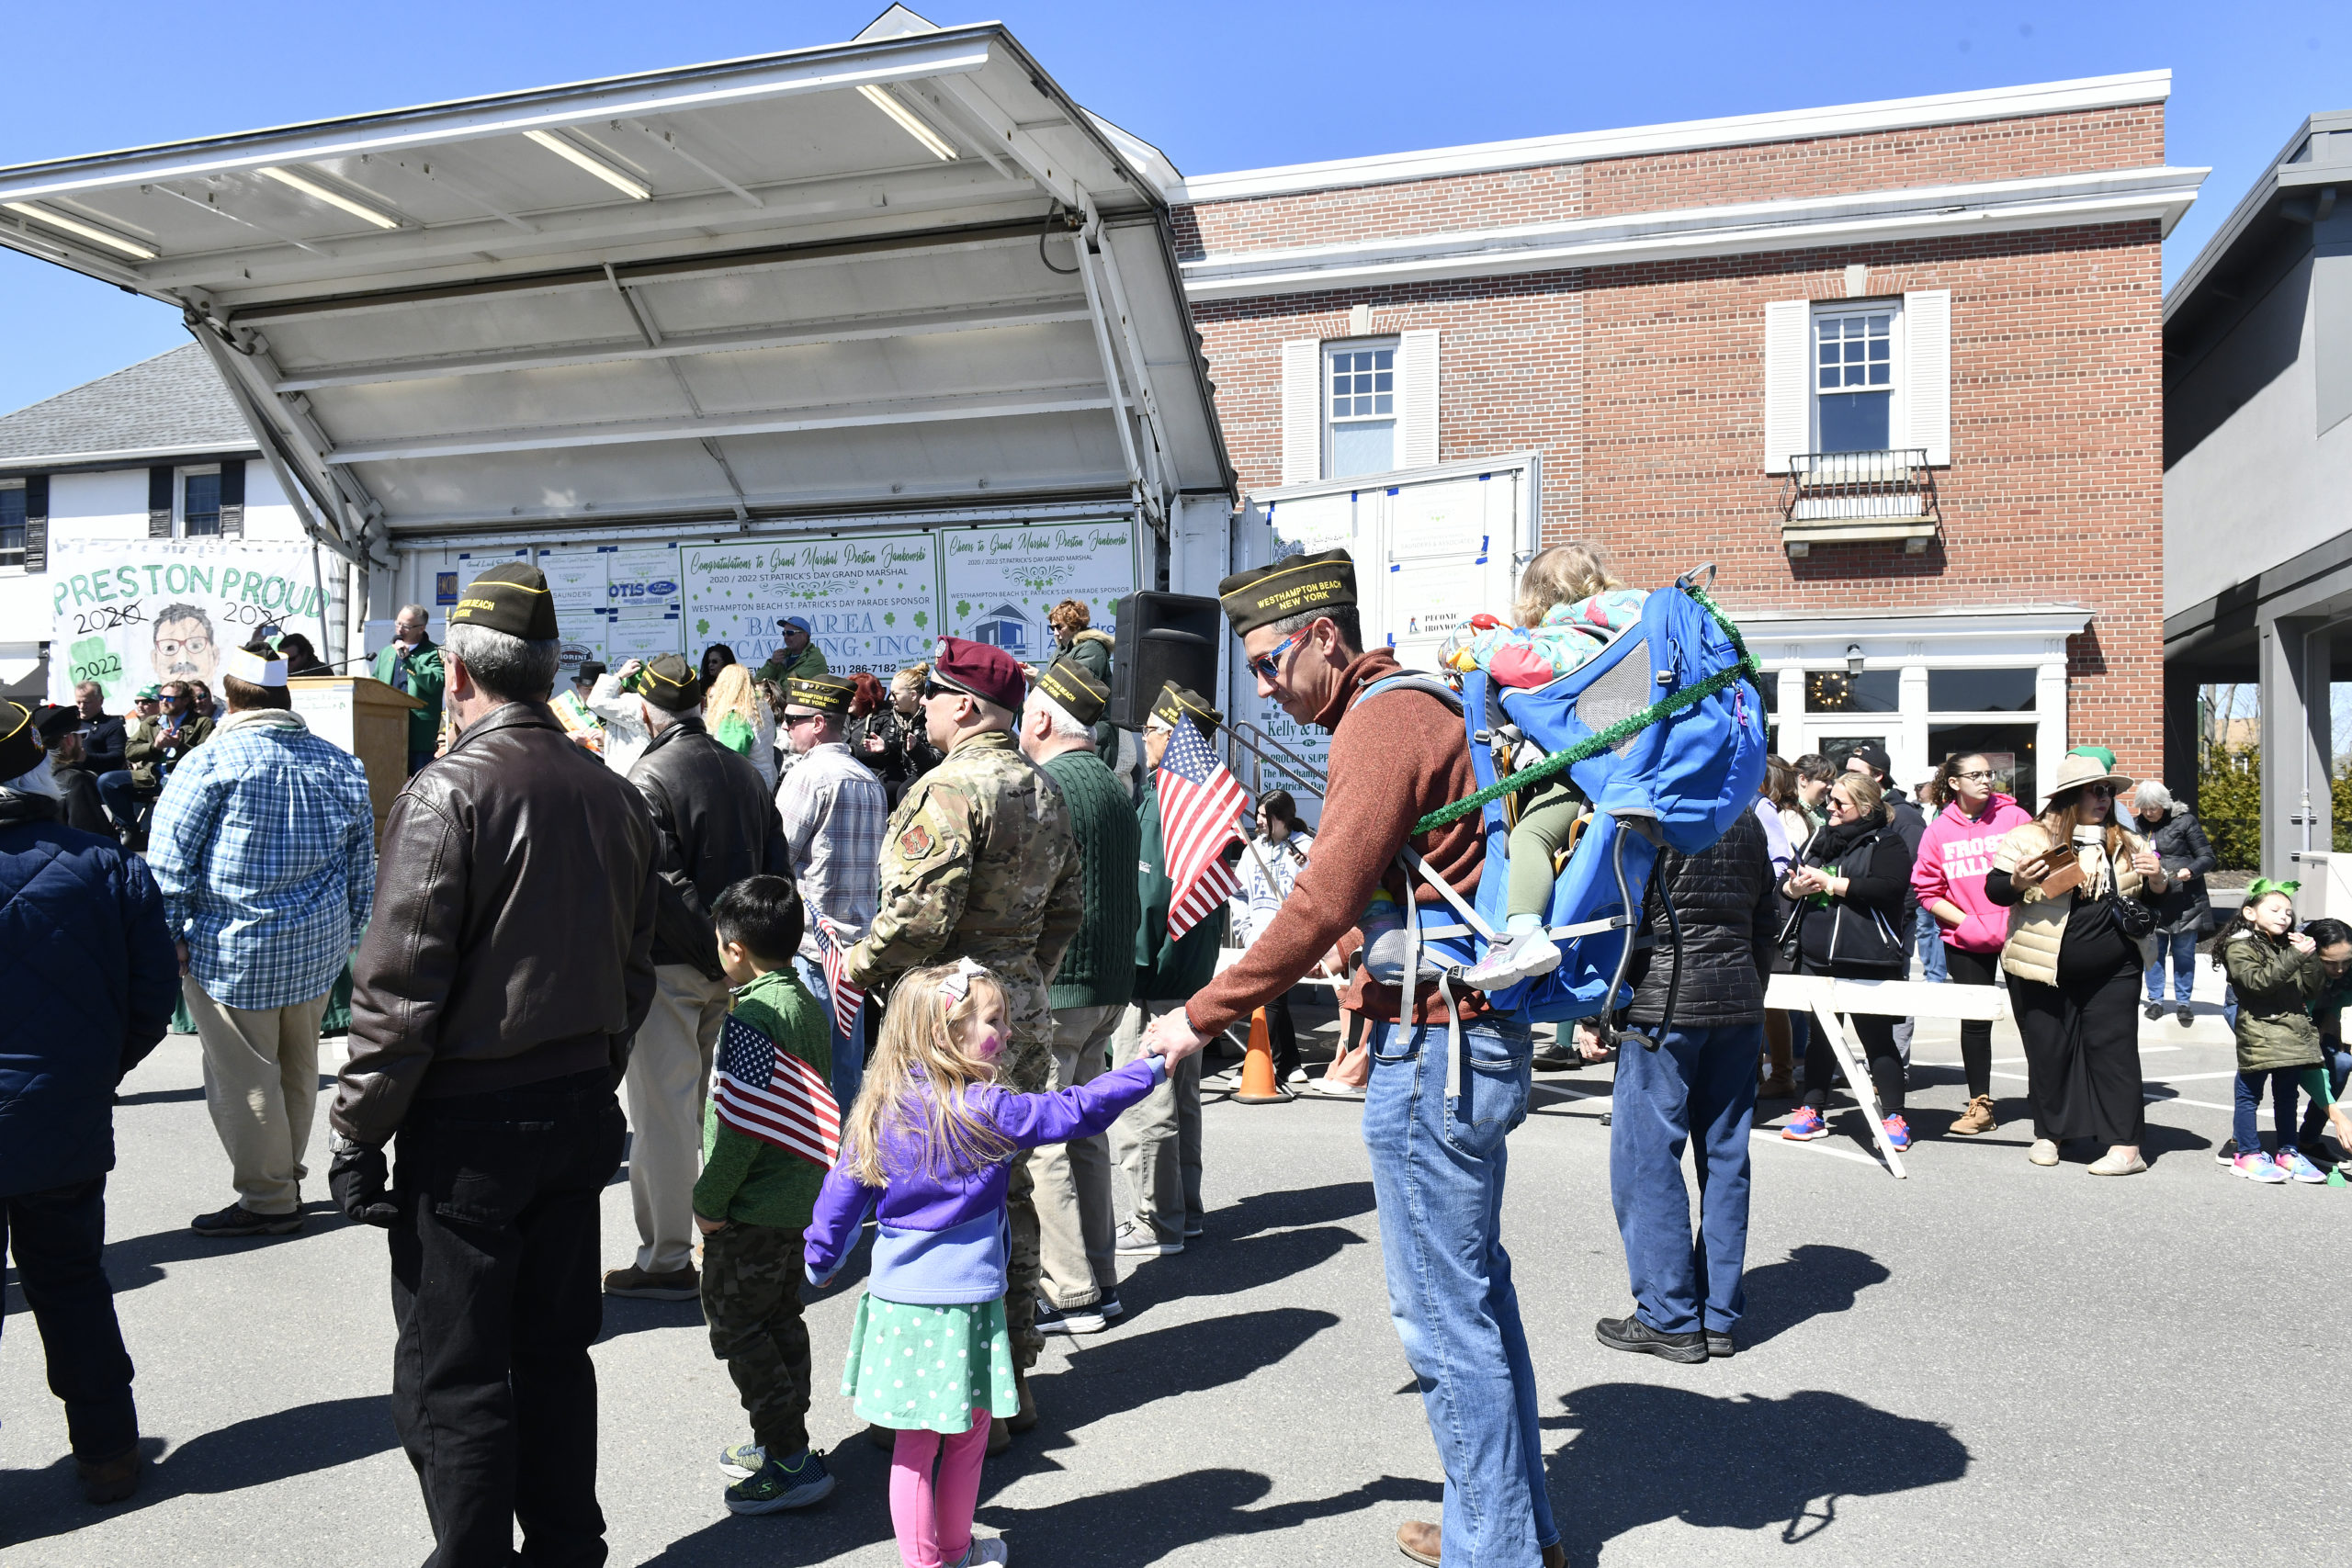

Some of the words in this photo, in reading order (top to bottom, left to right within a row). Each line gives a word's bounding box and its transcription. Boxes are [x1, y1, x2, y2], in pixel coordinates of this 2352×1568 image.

[949, 535, 974, 557] Cheers
[978, 539, 984, 551] to
[989, 533, 1012, 555] Grand
[1018, 531, 1050, 555] Marshal
[1055, 529, 1083, 550] Preston
[1088, 529, 1128, 551] Jankowski
[691, 552, 753, 575] Congratulations
[756, 555, 764, 568] to
[771, 547, 796, 572] Grand
[802, 546, 839, 571] Marshal
[843, 543, 876, 567] Preston
[881, 542, 927, 569] Jankowski
[709, 576, 729, 584] 2020
[738, 574, 758, 582] 2022
[814, 571, 831, 580] DAY
[832, 570, 864, 578] GRAND
[866, 568, 909, 577] MARSHAL
[53, 563, 214, 616] PRESTON
[220, 566, 332, 619] PROUD
[552, 591, 593, 599] SAUNDERS
[608, 582, 645, 598] OTIS
[950, 591, 998, 599] WESTHAMPTON
[1030, 588, 1060, 597] PATRICK'S
[1100, 586, 1129, 594] SPONSOR
[1256, 582, 1318, 609] WESTHAMPTON
[1318, 580, 1342, 592] BEACH
[470, 599, 495, 611] BEACH
[691, 603, 755, 613] WESTHAMPTON
[756, 602, 784, 611] BEACH
[785, 601, 796, 609] ST.
[797, 599, 837, 609] PATRICK'S
[839, 599, 855, 608] DAY
[857, 597, 889, 607] PARADE
[891, 596, 930, 605] SPONSOR
[1279, 597, 1301, 611] NEW
[1303, 591, 1329, 604] YORK
[745, 615, 791, 637] BA
[809, 612, 876, 635] AREA
[1425, 613, 1459, 622] PECONIC
[873, 635, 923, 657] INC.
[75, 655, 122, 682] 2022
[849, 663, 897, 673] 286-7182
[811, 698, 827, 707] YORK
[823, 694, 840, 705] BEACH
[1168, 715, 1179, 725] YOR
[1267, 720, 1296, 741] Kelly
[1300, 723, 1310, 736] &
[1263, 768, 1276, 778] The
[1279, 768, 1329, 779] Wethampon
[1263, 782, 1273, 791] St.
[1276, 782, 1308, 791] Patrick
[1310, 782, 1325, 792] Day
[1941, 854, 1994, 879] VALL
